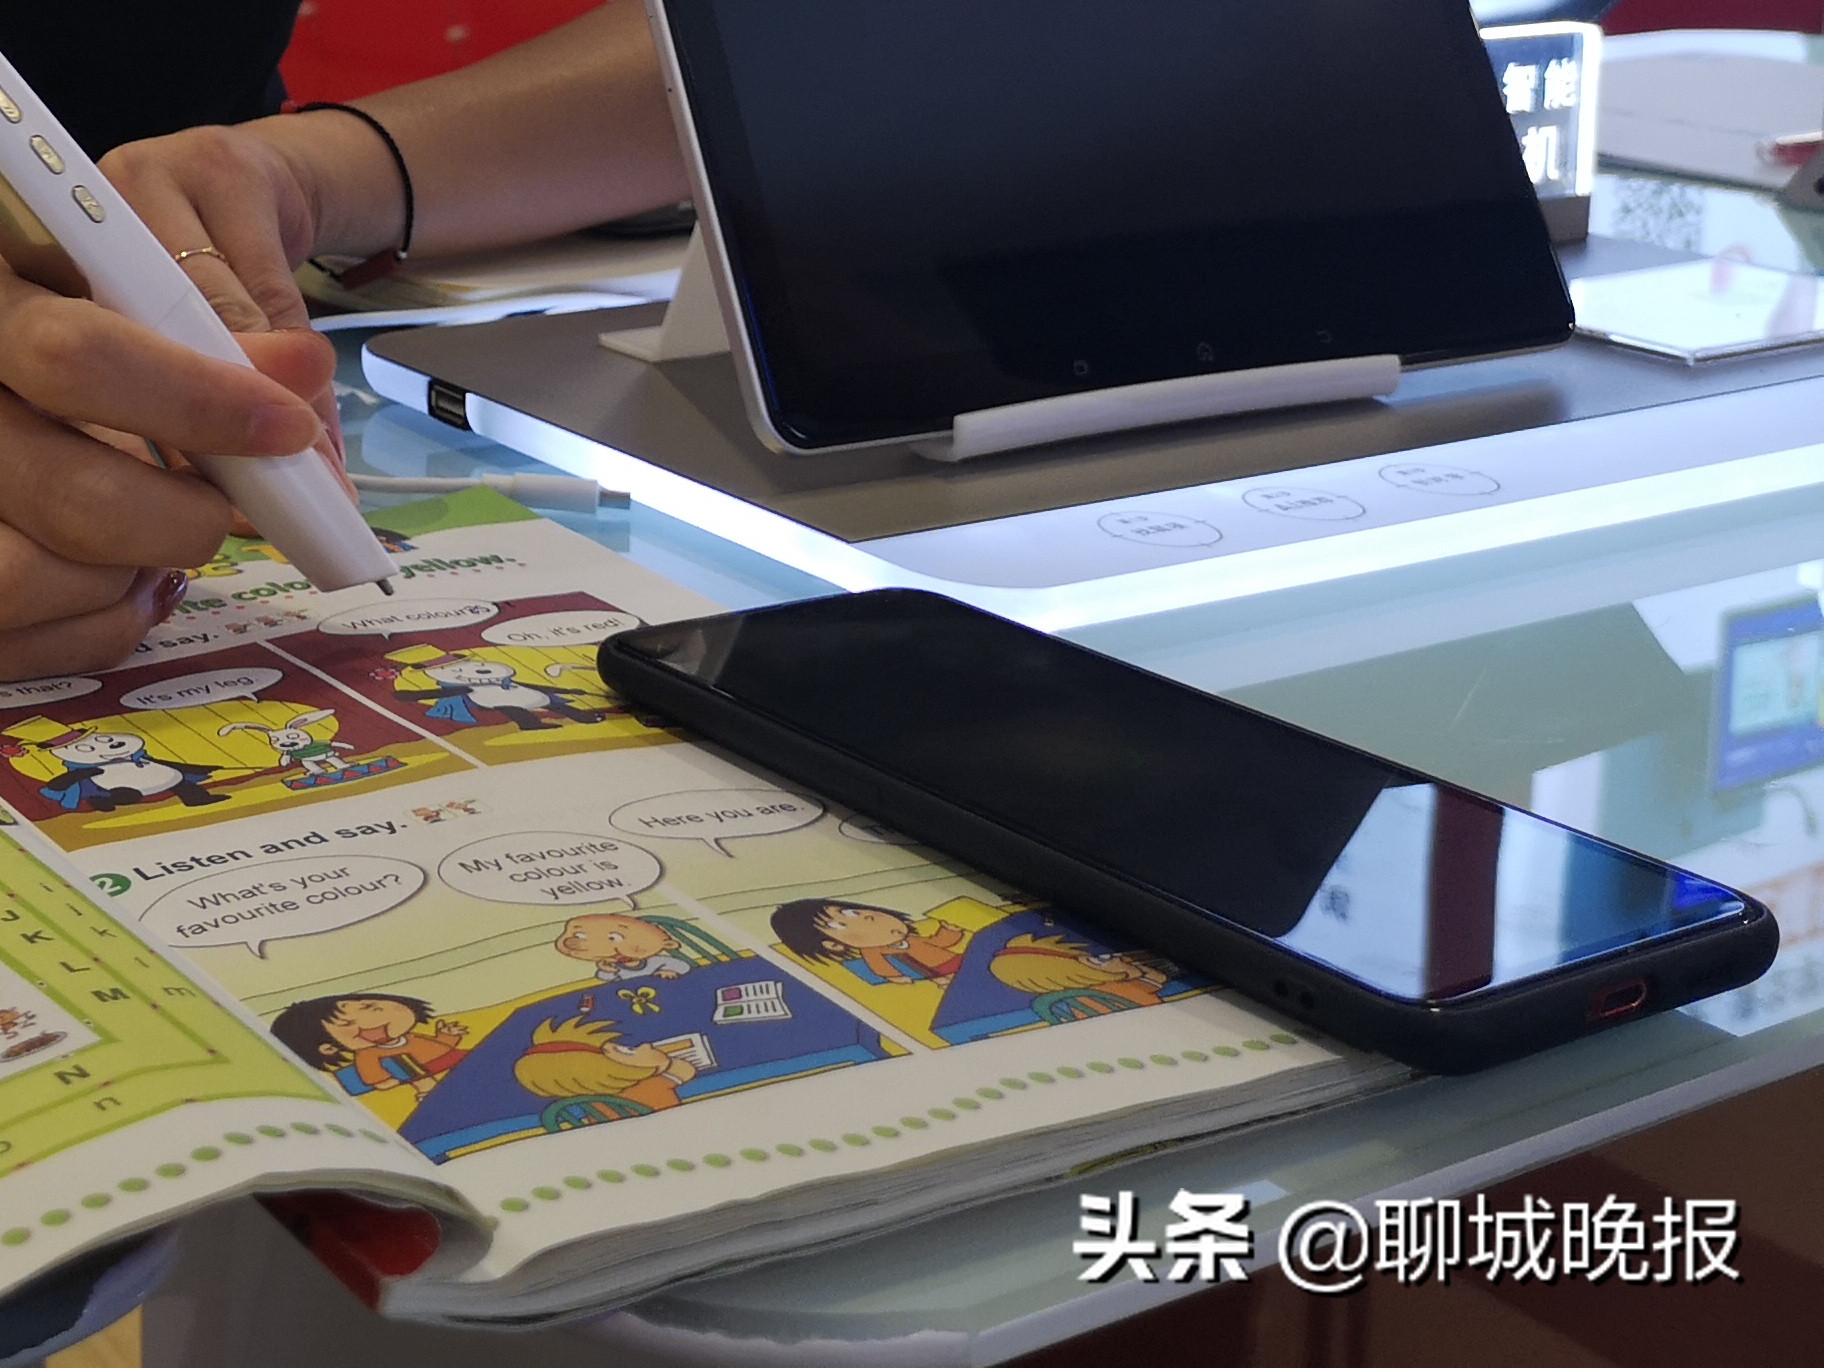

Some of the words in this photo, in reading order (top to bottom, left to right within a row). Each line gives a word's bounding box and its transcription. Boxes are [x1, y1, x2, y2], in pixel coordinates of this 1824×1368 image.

[341, 612, 404, 630] What
[551, 620, 582, 636] it's
[583, 615, 626, 632] red!
[159, 633, 219, 651] say.
[15, 681, 74, 696] that?
[136, 692, 174, 707] It's
[176, 684, 211, 700] my
[638, 810, 705, 830] Here
[706, 806, 753, 823] you
[755, 800, 806, 816] are.
[132, 848, 254, 881] Listen
[259, 832, 330, 856] and
[334, 819, 408, 840] say.
[457, 858, 504, 876] My
[505, 838, 620, 866] favourite
[508, 863, 590, 884] colour
[592, 858, 620, 871] is
[187, 881, 288, 911] What's
[290, 865, 352, 891] your
[176, 898, 301, 939] favourite
[305, 873, 403, 905] colour?
[0, 909, 20, 922] J
[20, 930, 55, 944] K
[59, 961, 92, 973] L
[90, 987, 131, 1003] M
[53, 1064, 92, 1085] N
